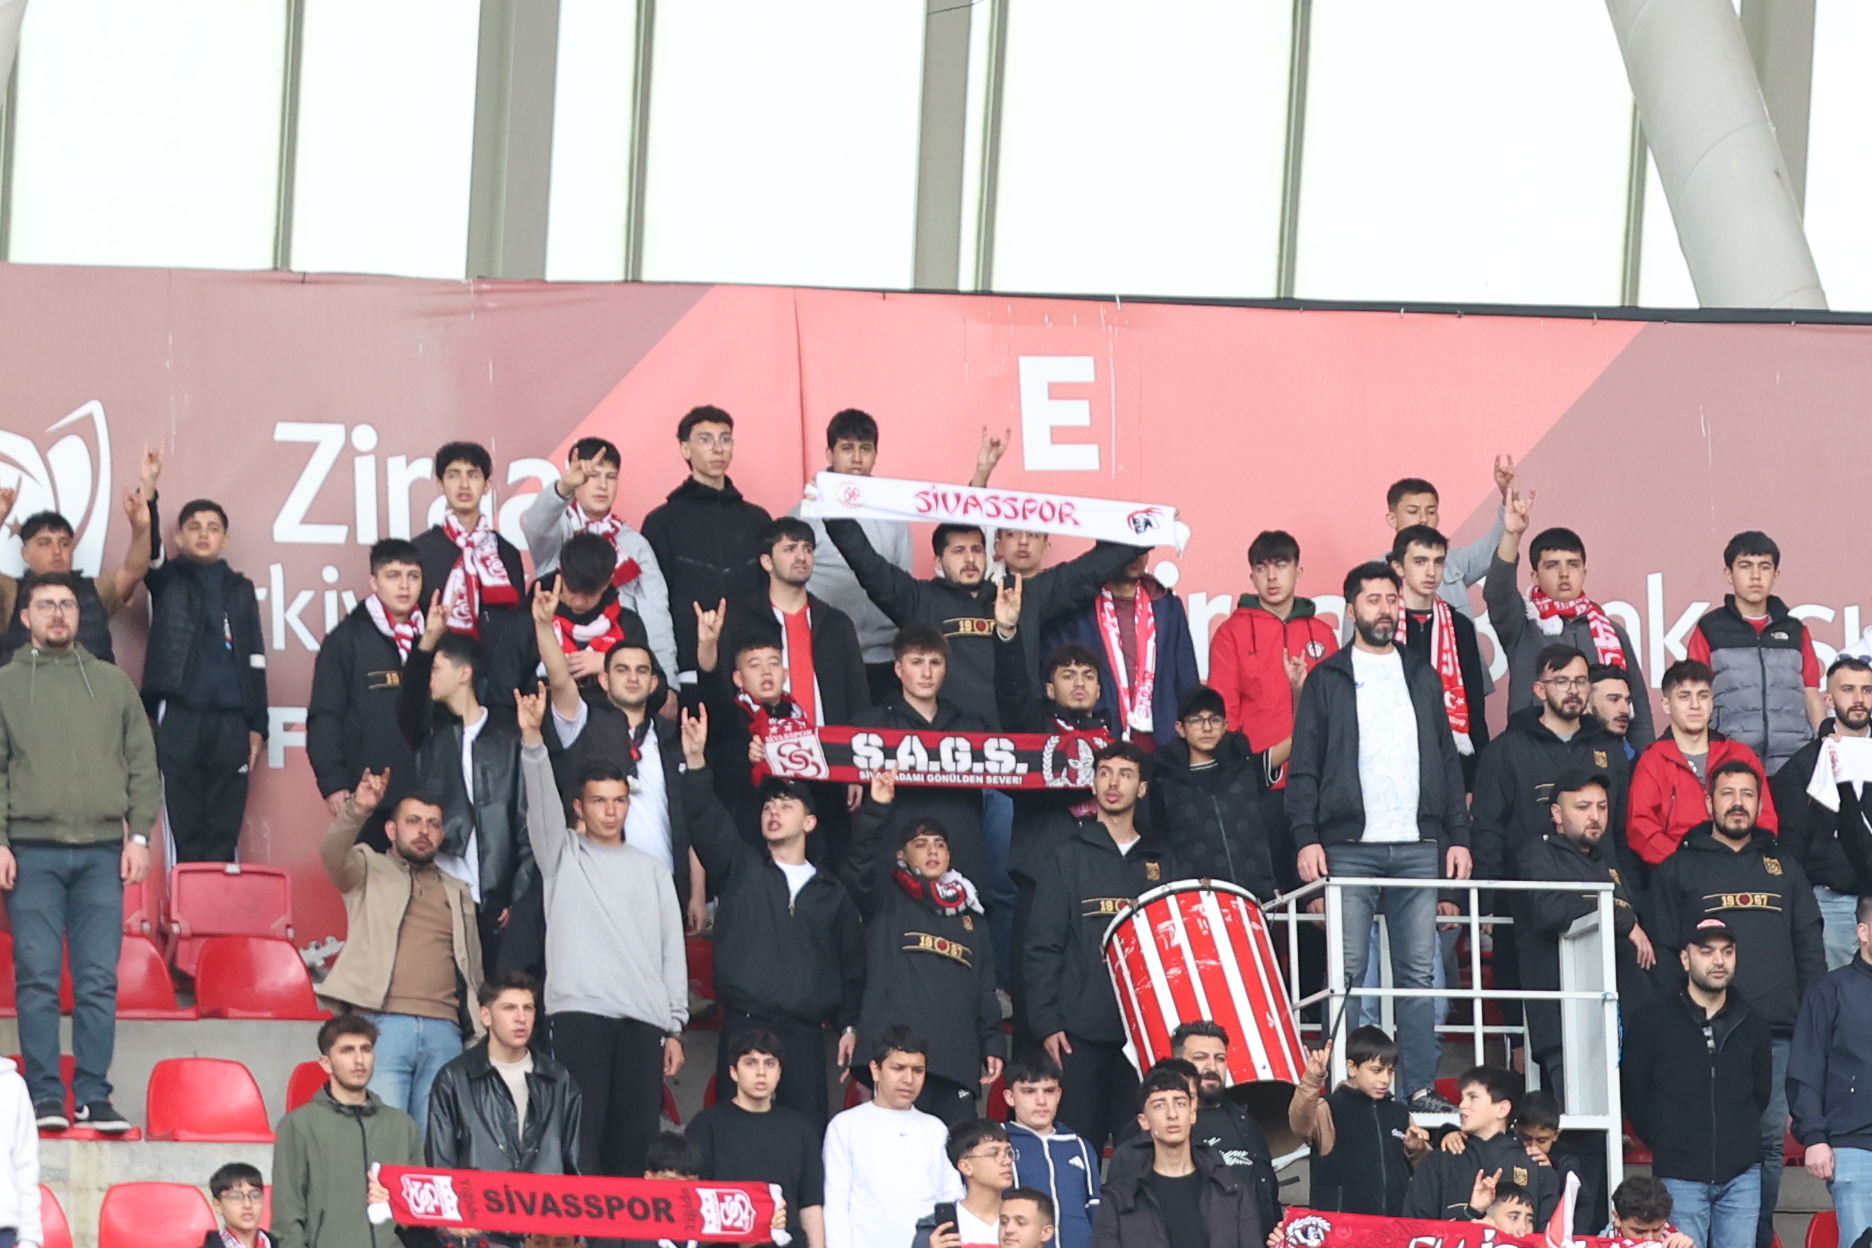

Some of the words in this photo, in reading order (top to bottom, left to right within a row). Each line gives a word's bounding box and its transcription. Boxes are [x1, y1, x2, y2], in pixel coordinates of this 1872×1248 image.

[1018, 355, 1100, 471] E
[851, 731, 1029, 775] S.A.G.S.
[482, 1184, 676, 1225] SİVASSPOR
